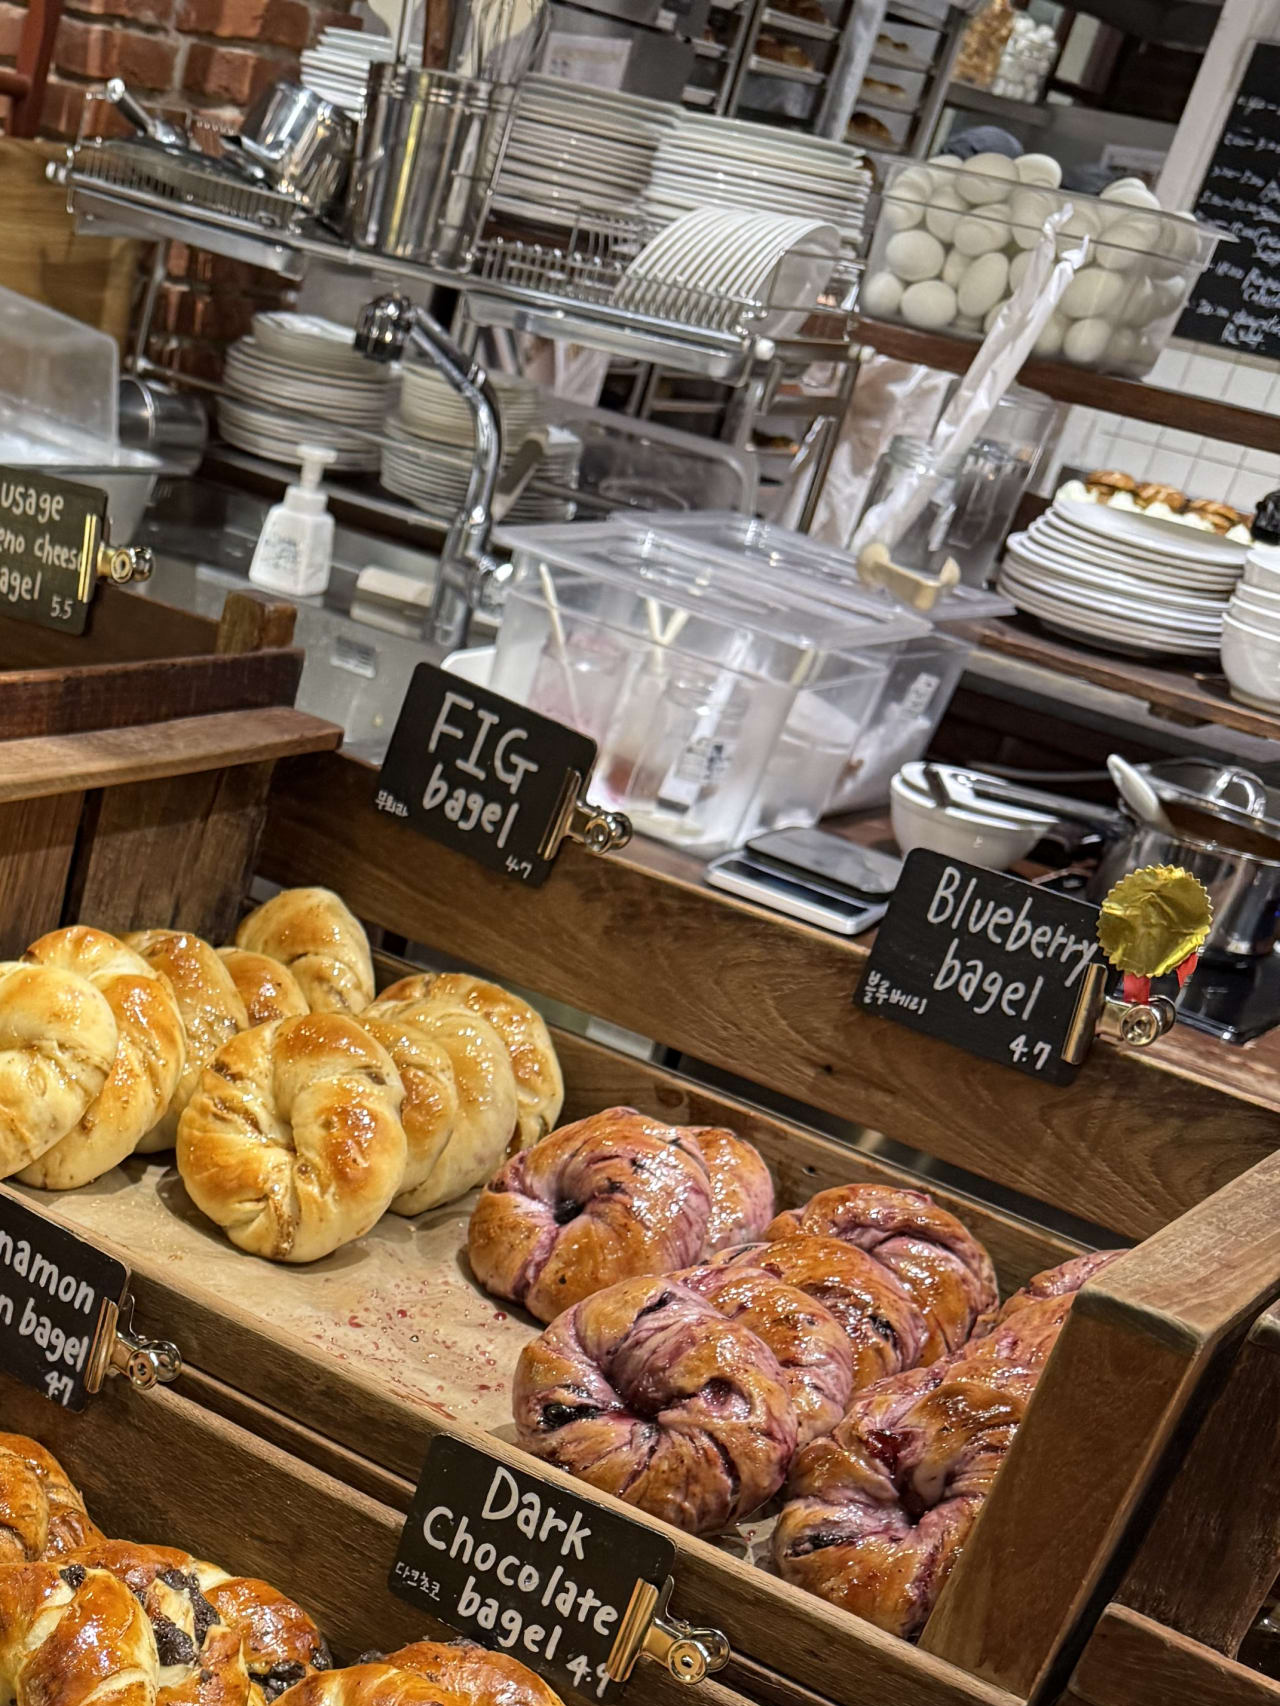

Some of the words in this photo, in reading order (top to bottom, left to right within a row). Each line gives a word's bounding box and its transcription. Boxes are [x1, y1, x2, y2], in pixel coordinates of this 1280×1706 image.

[50, 595, 73, 619] 5.5
[428, 691, 539, 795] FIG
[422, 762, 519, 849] bagel
[927, 865, 1099, 988] Blueberry
[863, 969, 928, 1016] 블루베리
[933, 938, 1045, 1022] bagel
[1008, 1033, 1052, 1071] 4.7
[19, 1297, 90, 1373] bagel
[481, 1466, 592, 1560] Dark
[394, 1560, 441, 1602] 다크초코
[423, 1506, 618, 1637] Chocolate
[456, 1575, 562, 1661] bagel
